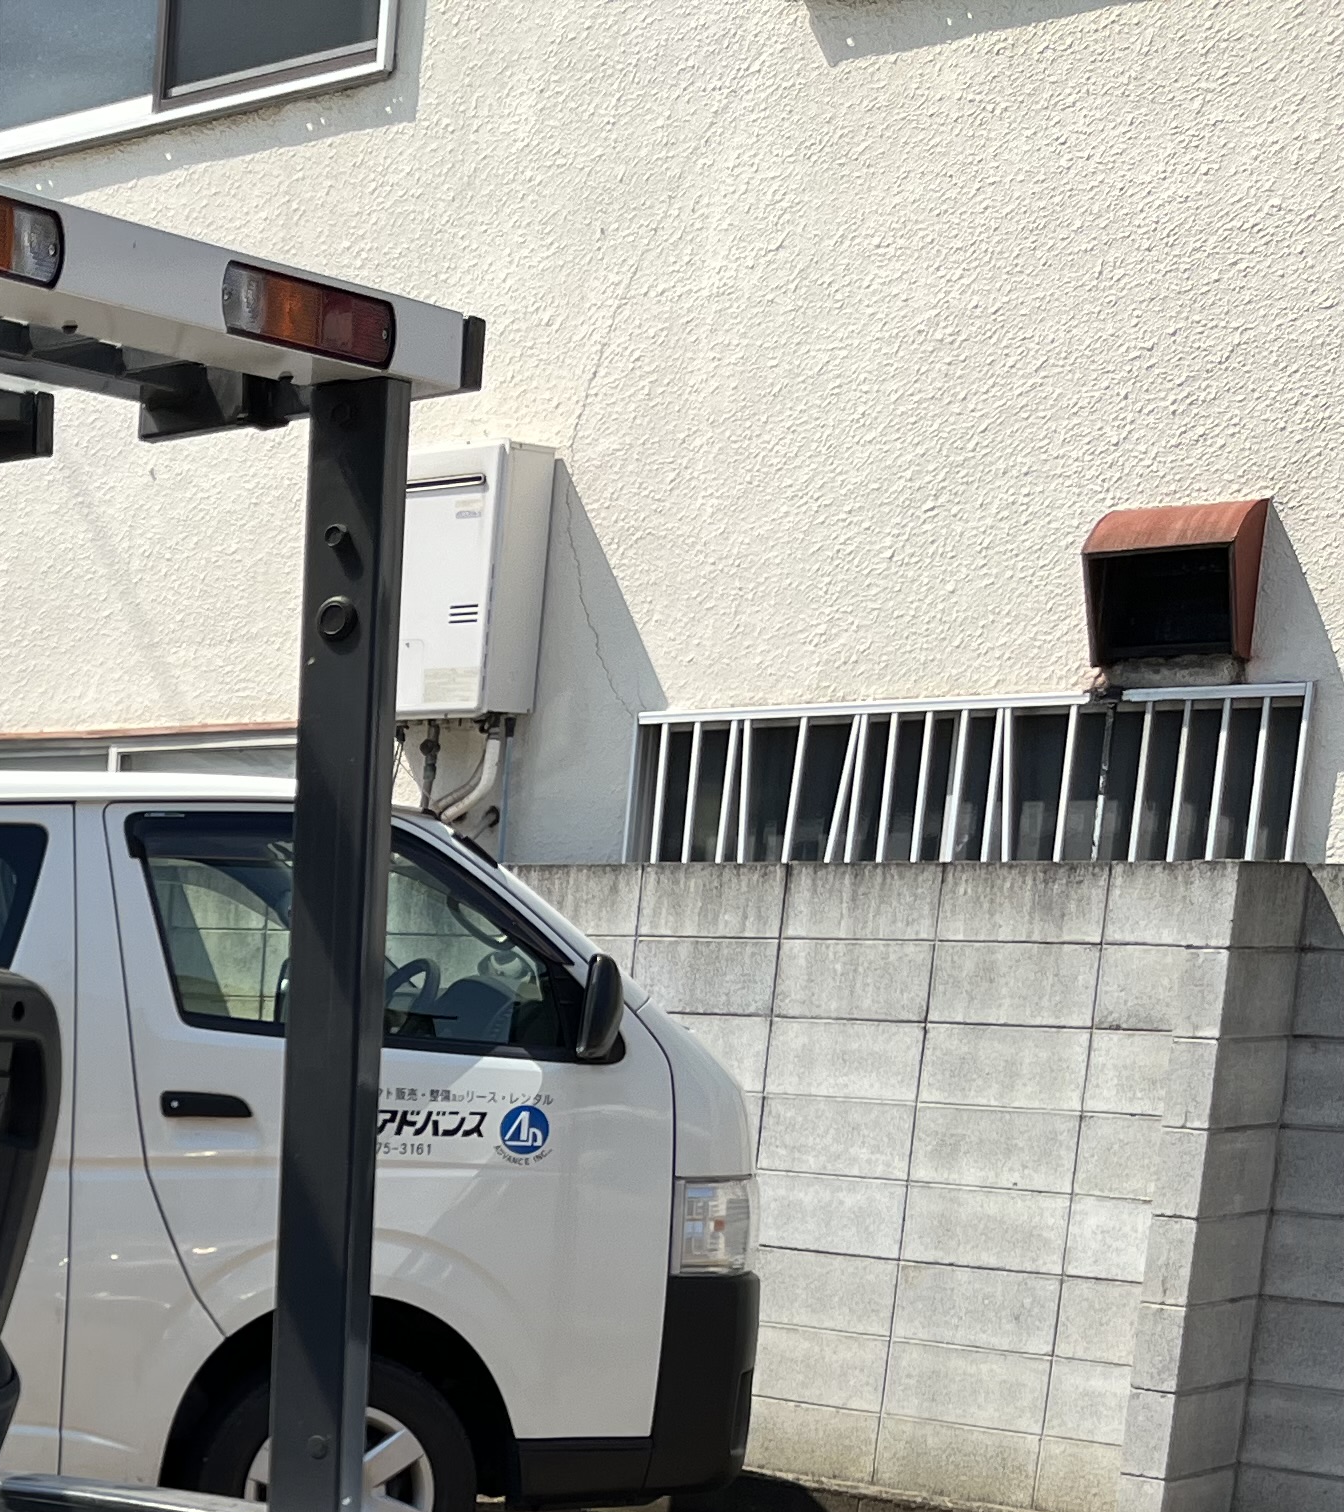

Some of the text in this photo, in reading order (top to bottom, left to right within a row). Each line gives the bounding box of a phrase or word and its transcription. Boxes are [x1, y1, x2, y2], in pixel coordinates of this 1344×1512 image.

[376, 1109, 488, 1138] アドバンス
